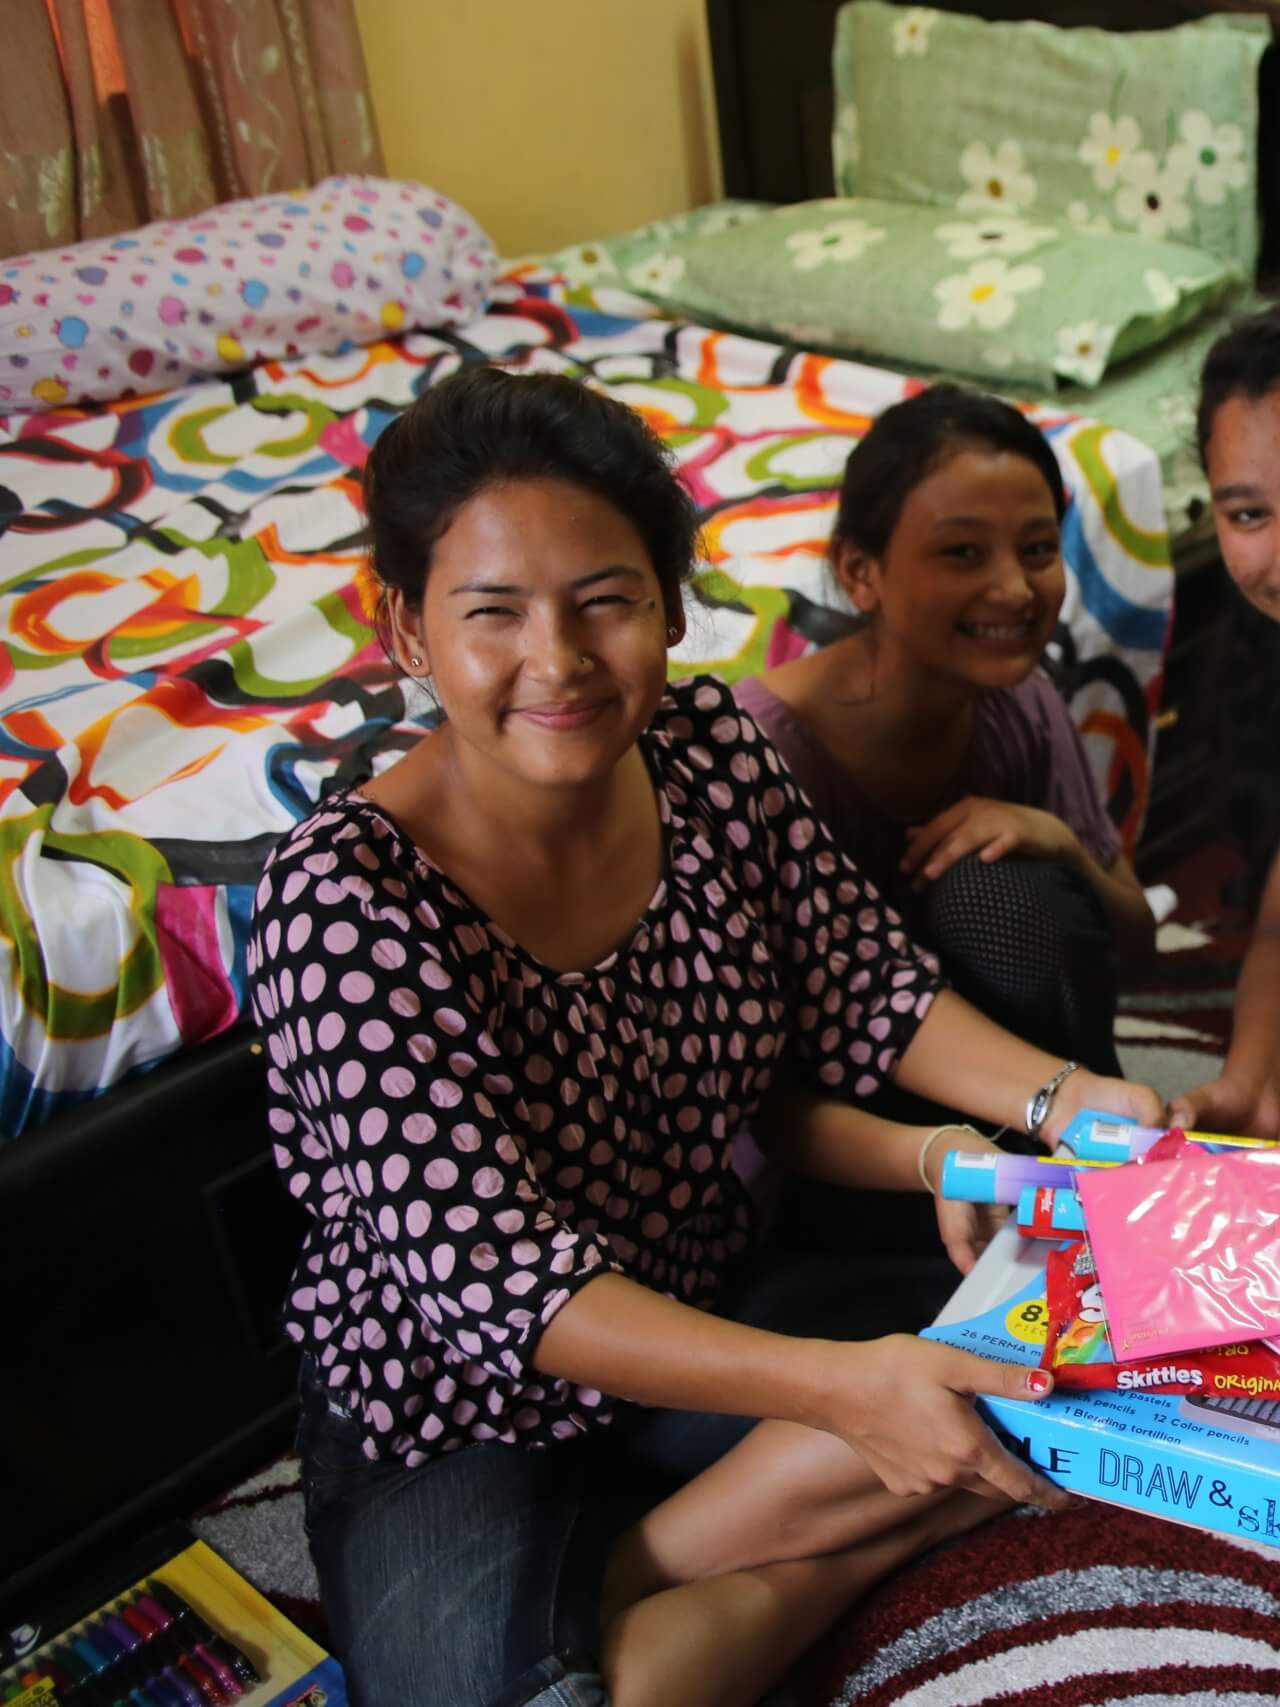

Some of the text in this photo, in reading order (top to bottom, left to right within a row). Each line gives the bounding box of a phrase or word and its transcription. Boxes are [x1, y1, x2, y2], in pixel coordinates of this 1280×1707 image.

[1020, 1304, 1048, 1328] 8
[961, 1329, 977, 1339] 26
[981, 1334, 1026, 1353] PERMA
[1116, 1366, 1204, 1390] Skittles
[1128, 1390, 1172, 1409] pastels
[1063, 1405, 1182, 1446] 1 Blending tortillion
[1094, 1397, 1137, 1416] pencils
[1152, 1412, 1167, 1425] 12
[1170, 1417, 1204, 1434] Color
[1207, 1427, 1251, 1447] pencils
[1099, 1447, 1204, 1509] DRAW
[1208, 1479, 1235, 1510] &
